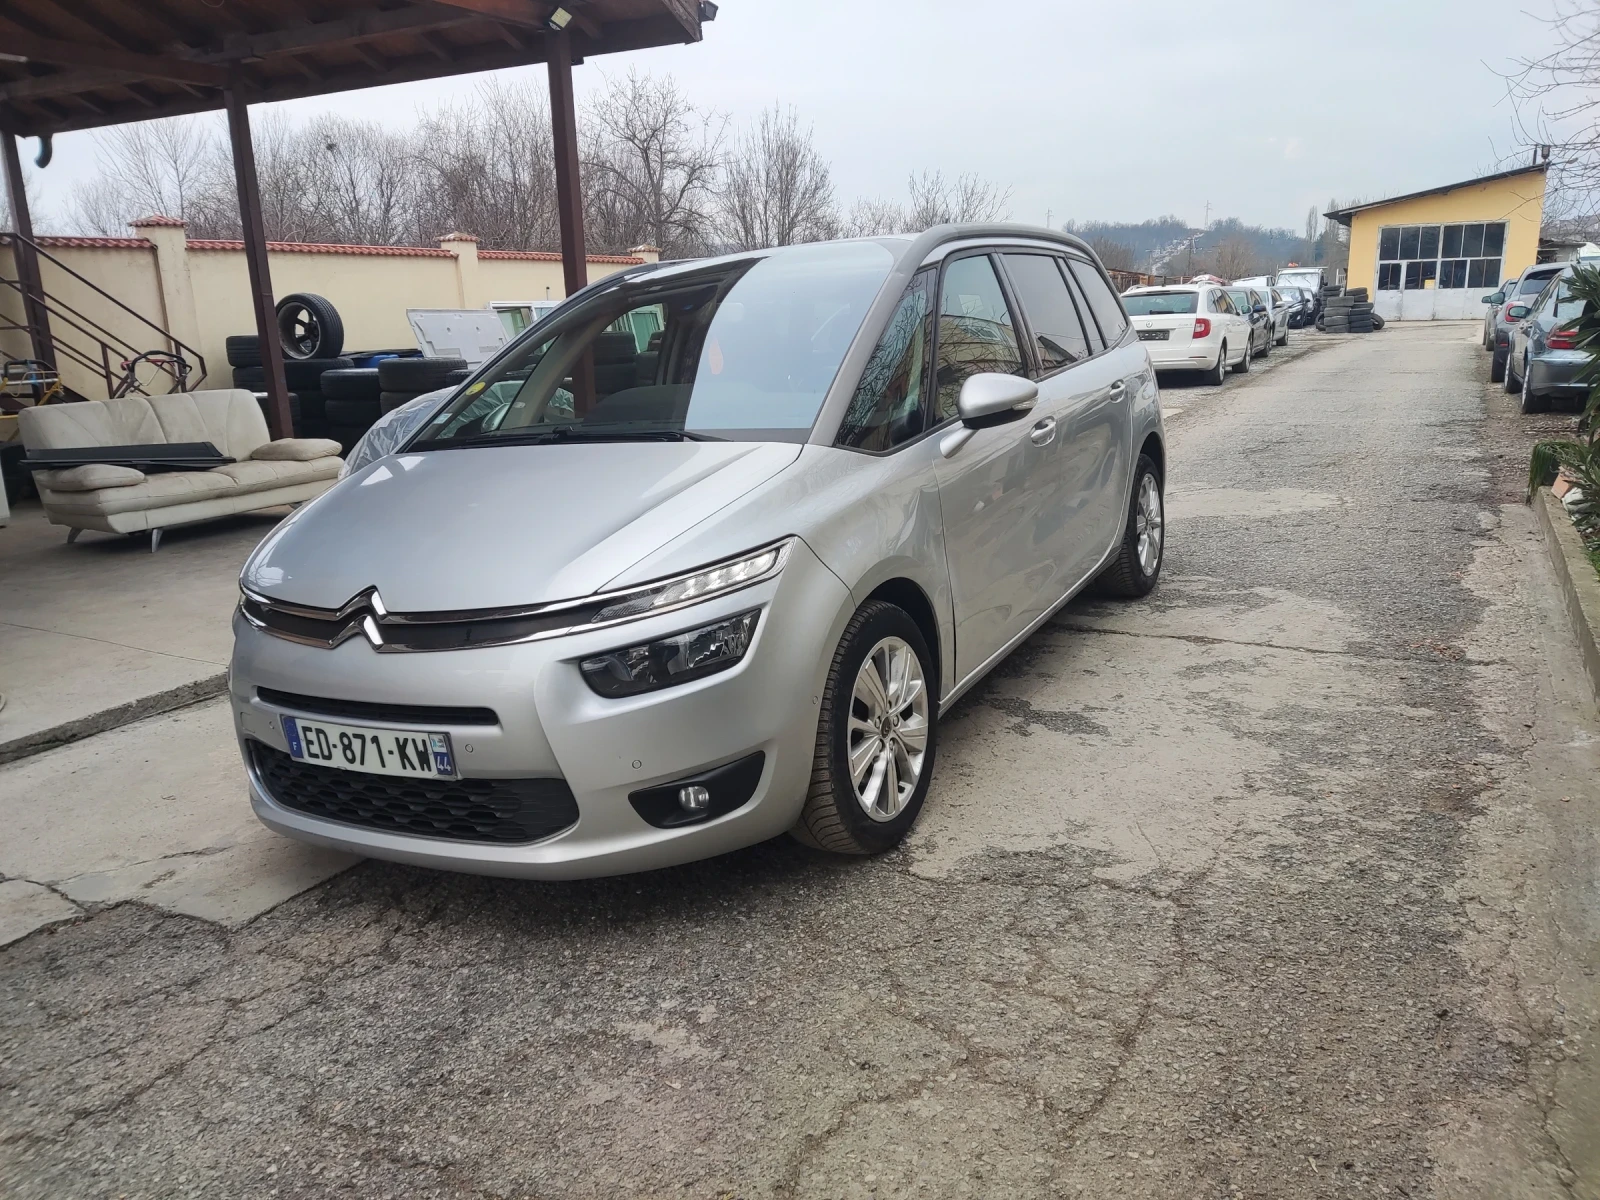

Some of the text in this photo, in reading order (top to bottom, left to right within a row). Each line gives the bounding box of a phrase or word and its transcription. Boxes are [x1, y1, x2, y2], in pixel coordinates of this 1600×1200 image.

[292, 741, 298, 751] F
[301, 725, 432, 772] ED-871-KW
[437, 755, 451, 771] 44
